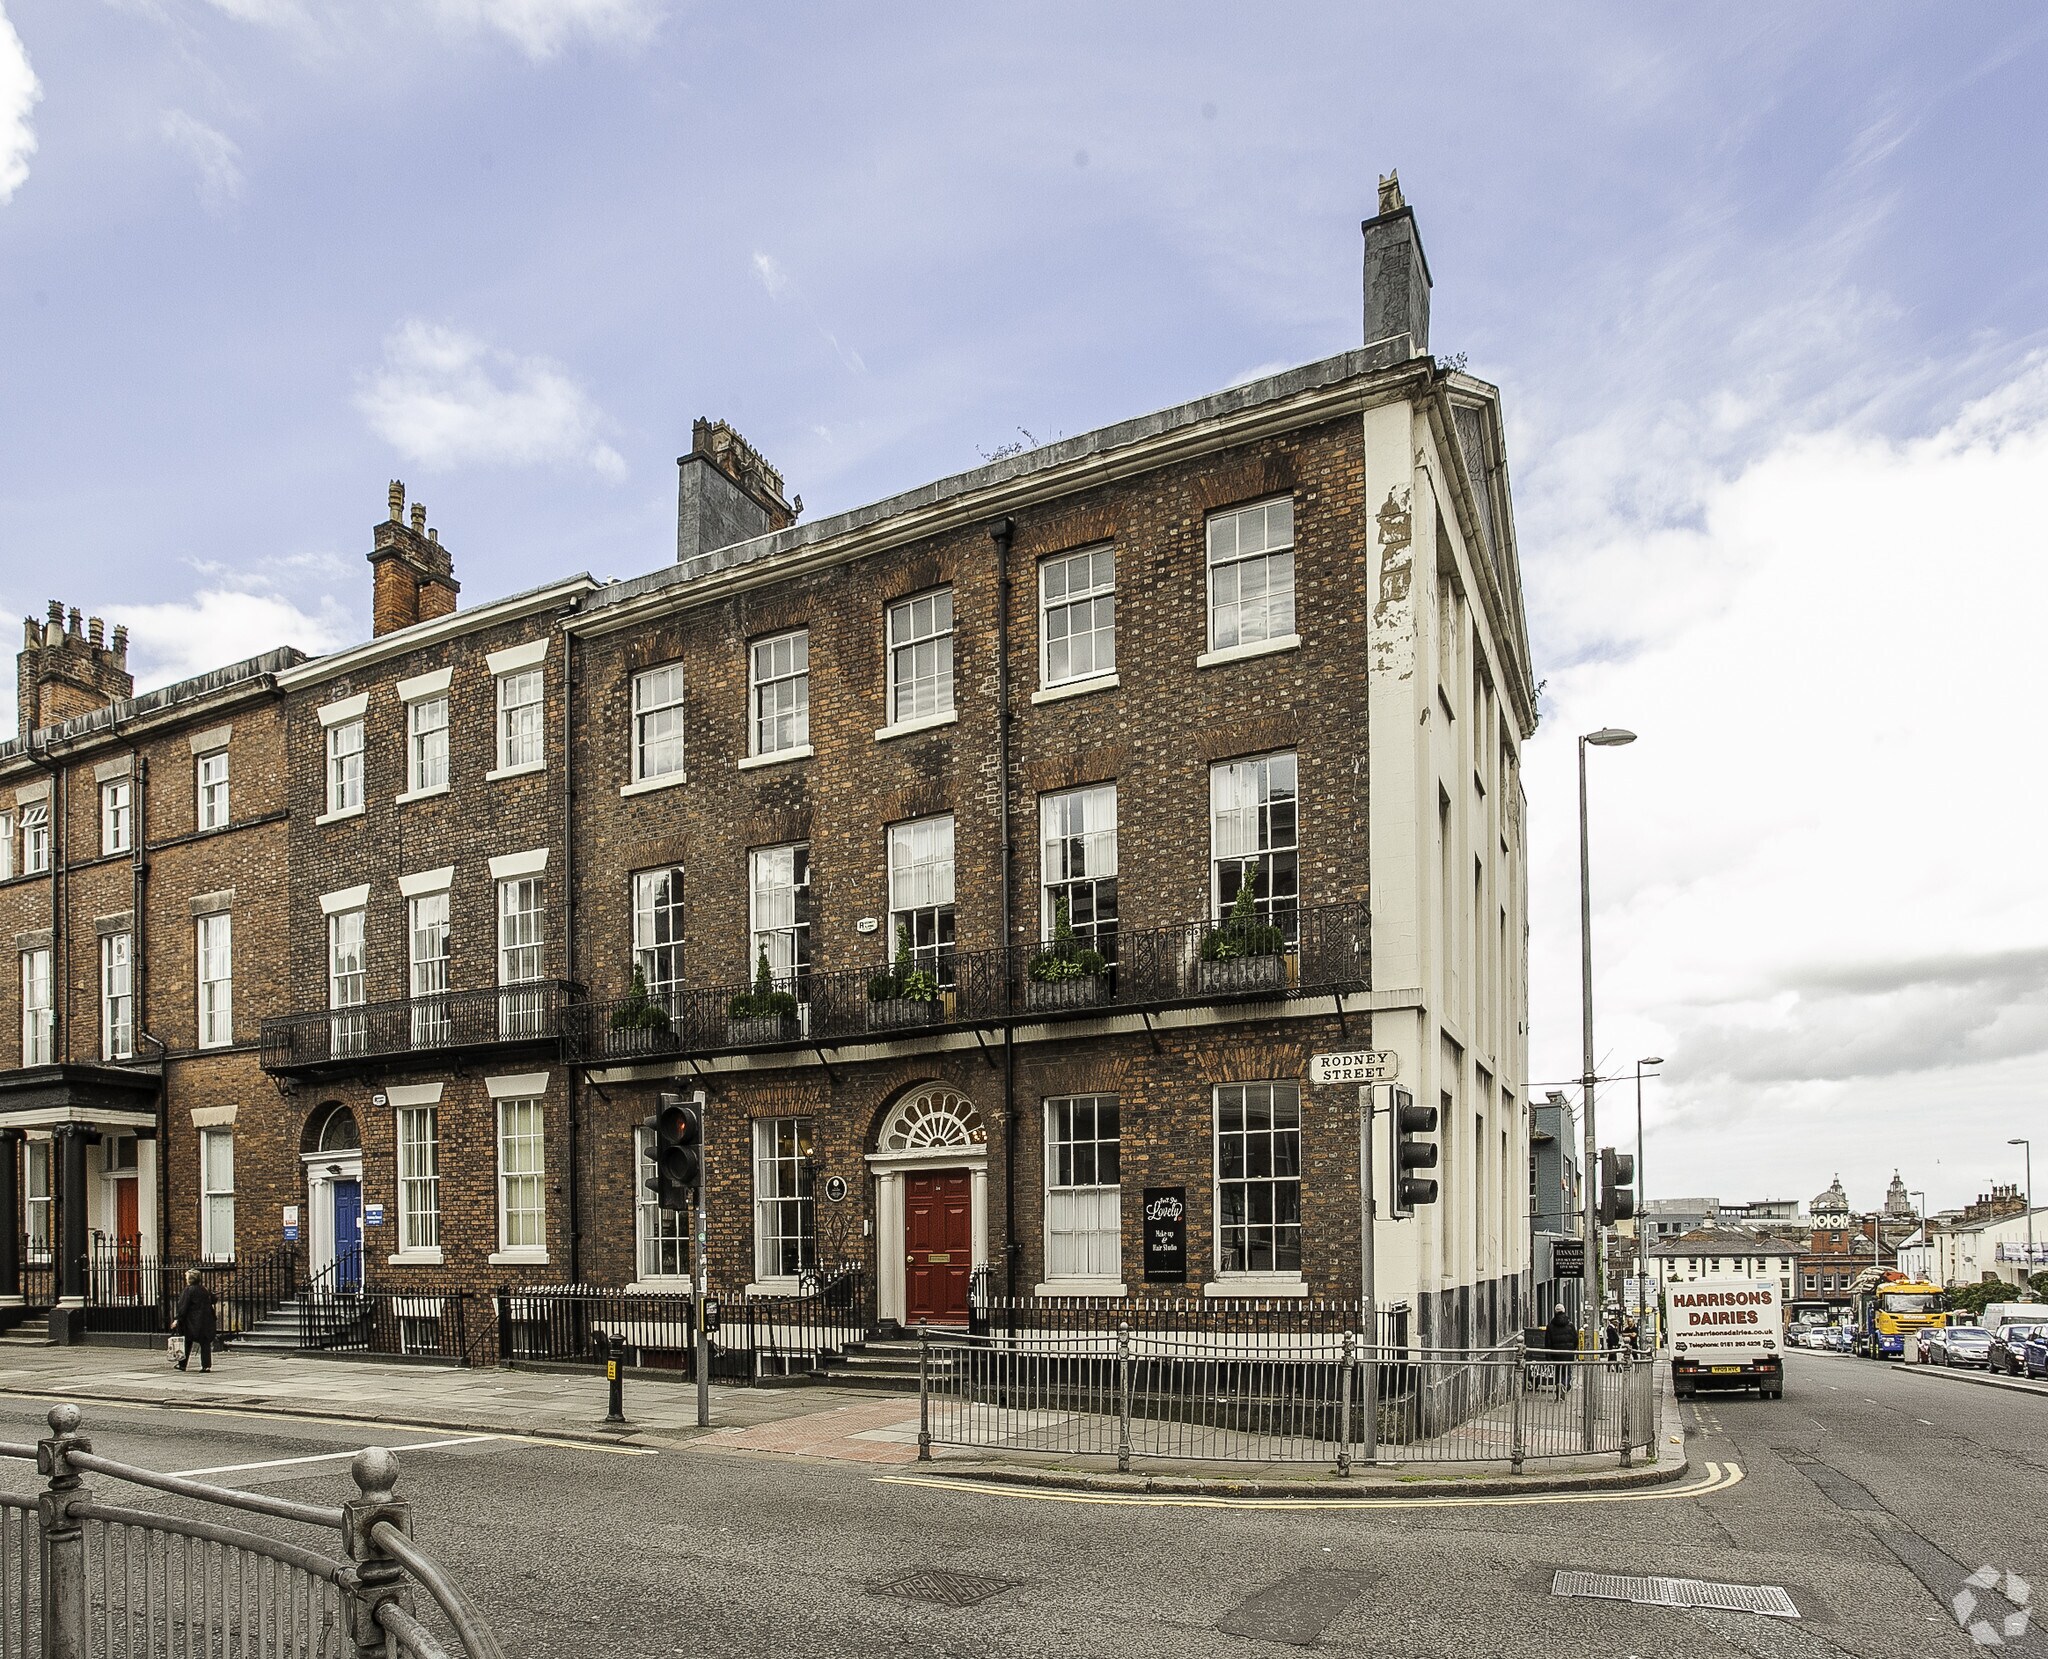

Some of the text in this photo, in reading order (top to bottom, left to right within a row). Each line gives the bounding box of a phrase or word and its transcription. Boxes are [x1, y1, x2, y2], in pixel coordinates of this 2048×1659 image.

[1320, 1053, 1388, 1067] RODNEY
[1323, 1067, 1385, 1080] STREET
[1146, 1200, 1183, 1221] Lovely
[1673, 1291, 1772, 1307] HARRISONS
[1689, 1310, 1759, 1325] DAIRIES
[1676, 1329, 1773, 1337] www.harrisonsdairies.co.uk
